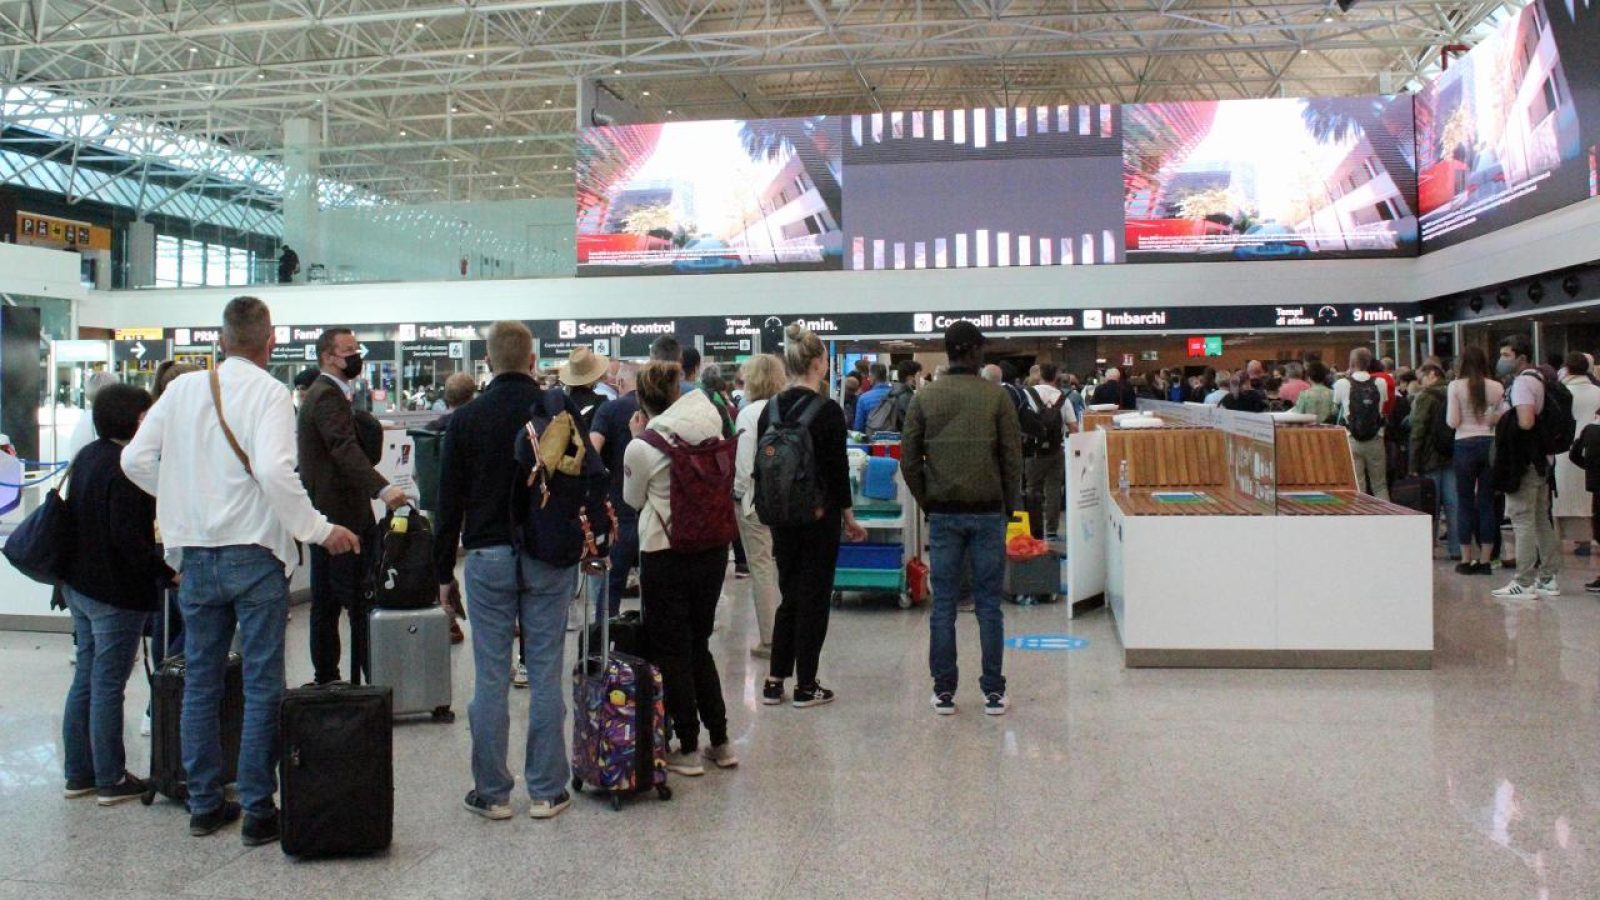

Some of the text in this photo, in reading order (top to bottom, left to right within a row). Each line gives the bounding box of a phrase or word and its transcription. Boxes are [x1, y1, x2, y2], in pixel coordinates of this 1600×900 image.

[1106, 312, 1166, 325] Imbarchi
[1275, 307, 1303, 319] Tempi
[1352, 307, 1398, 322] 9 min.
[725, 317, 751, 328] Tempi
[807, 317, 838, 331] min.
[935, 313, 1074, 328] Coolli di sicurezza
[1276, 317, 1286, 325] di
[420, 325, 476, 338] Fast Track
[579, 321, 675, 337] Security control
[725, 327, 735, 335] di
[194, 331, 218, 342] PRM
